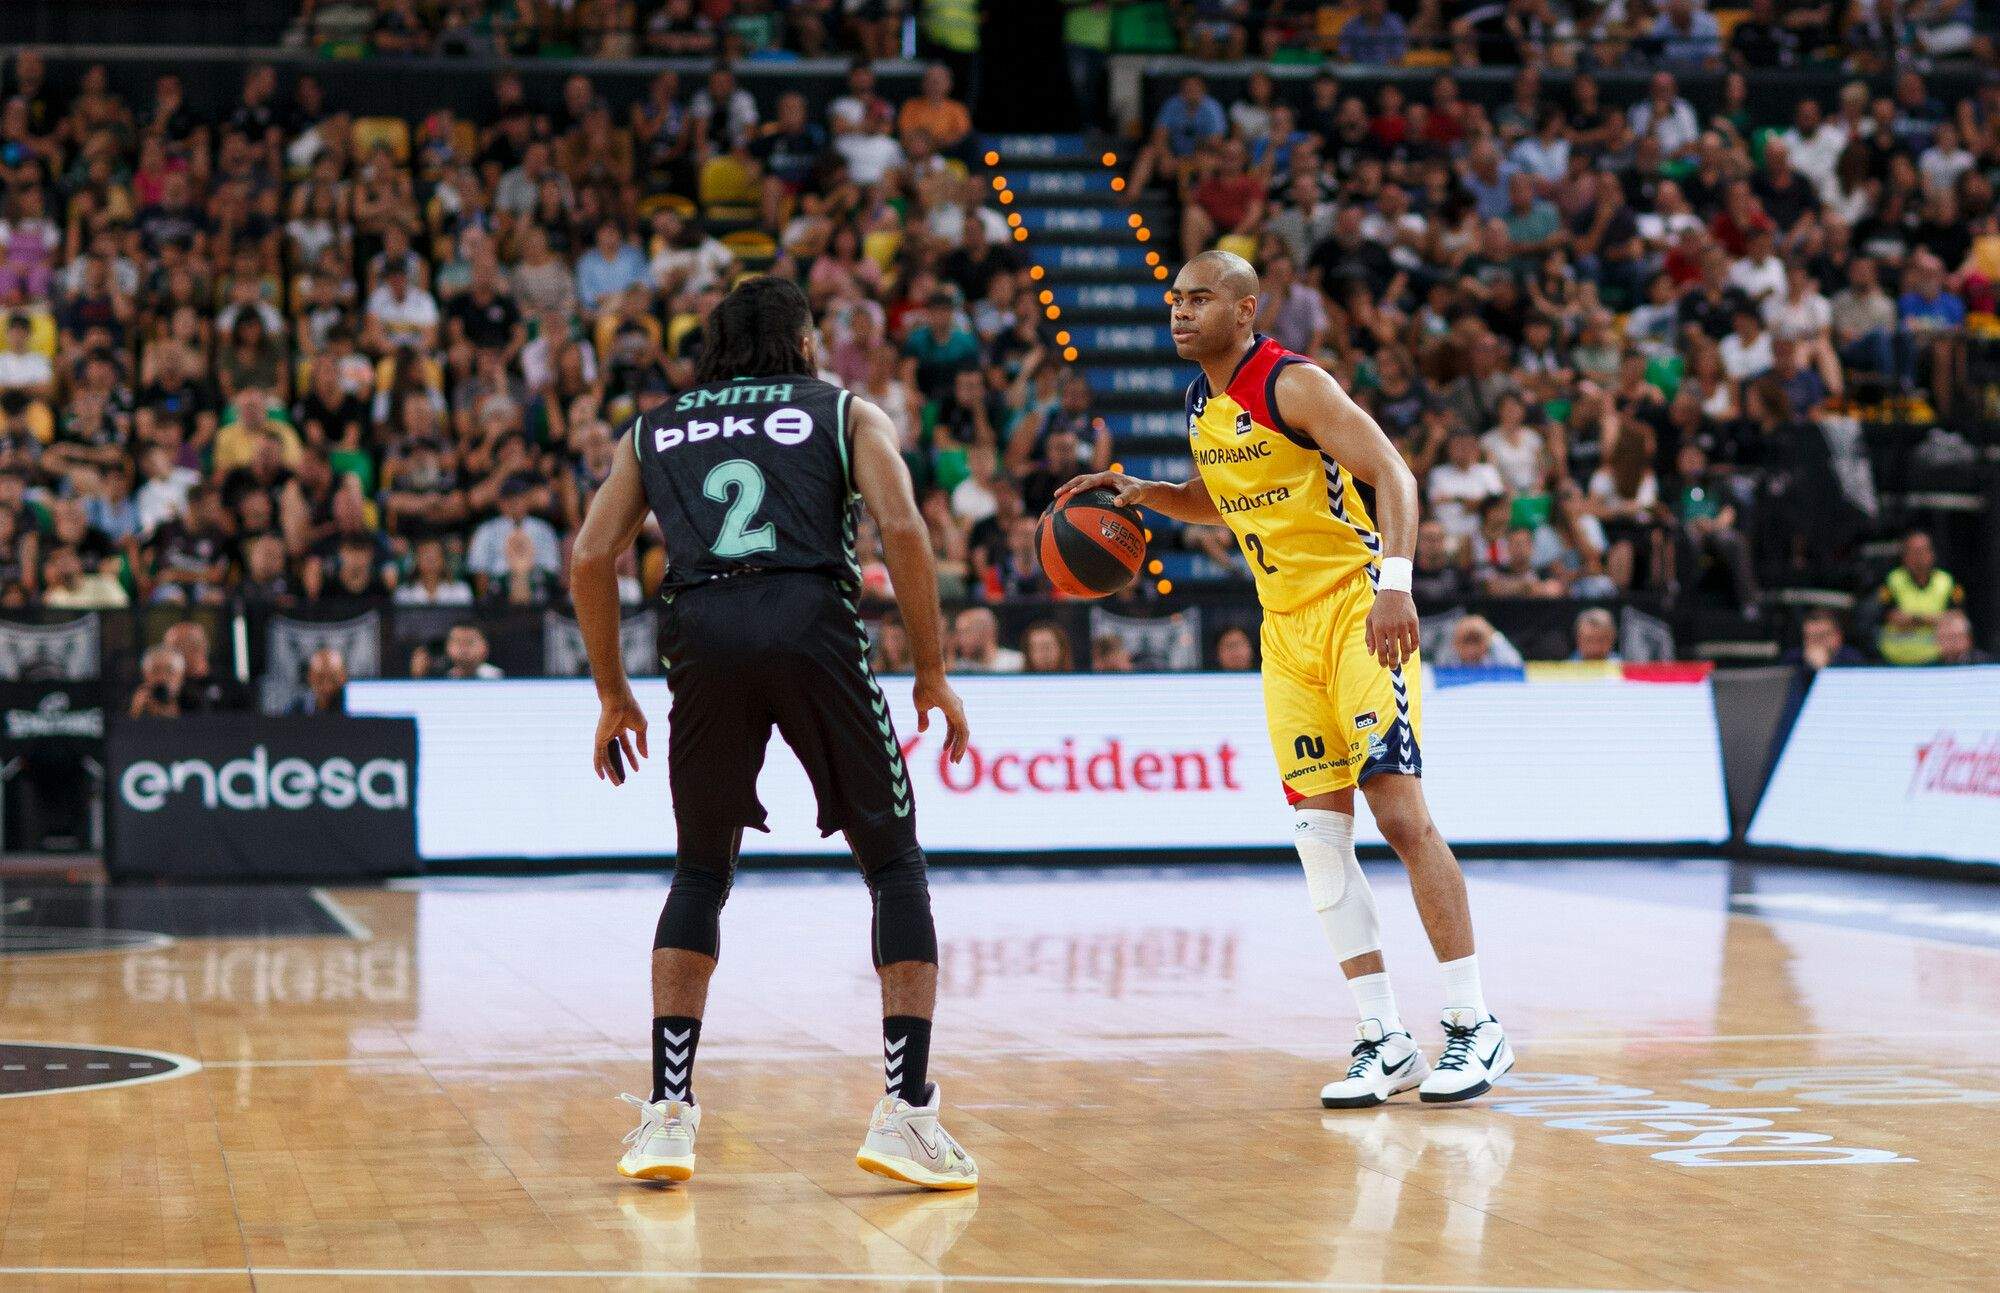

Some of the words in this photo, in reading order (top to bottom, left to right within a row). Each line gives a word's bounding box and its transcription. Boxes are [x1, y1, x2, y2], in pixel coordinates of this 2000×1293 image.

[675, 383, 794, 412] SMITH
[654, 416, 756, 452] bbk
[1199, 440, 1272, 466] MORABANC
[703, 458, 776, 558] 2
[1244, 533, 1279, 575] 2
[120, 744, 409, 812] endesa
[939, 738, 1241, 794] Occident
[1318, 762, 1329, 770] la
